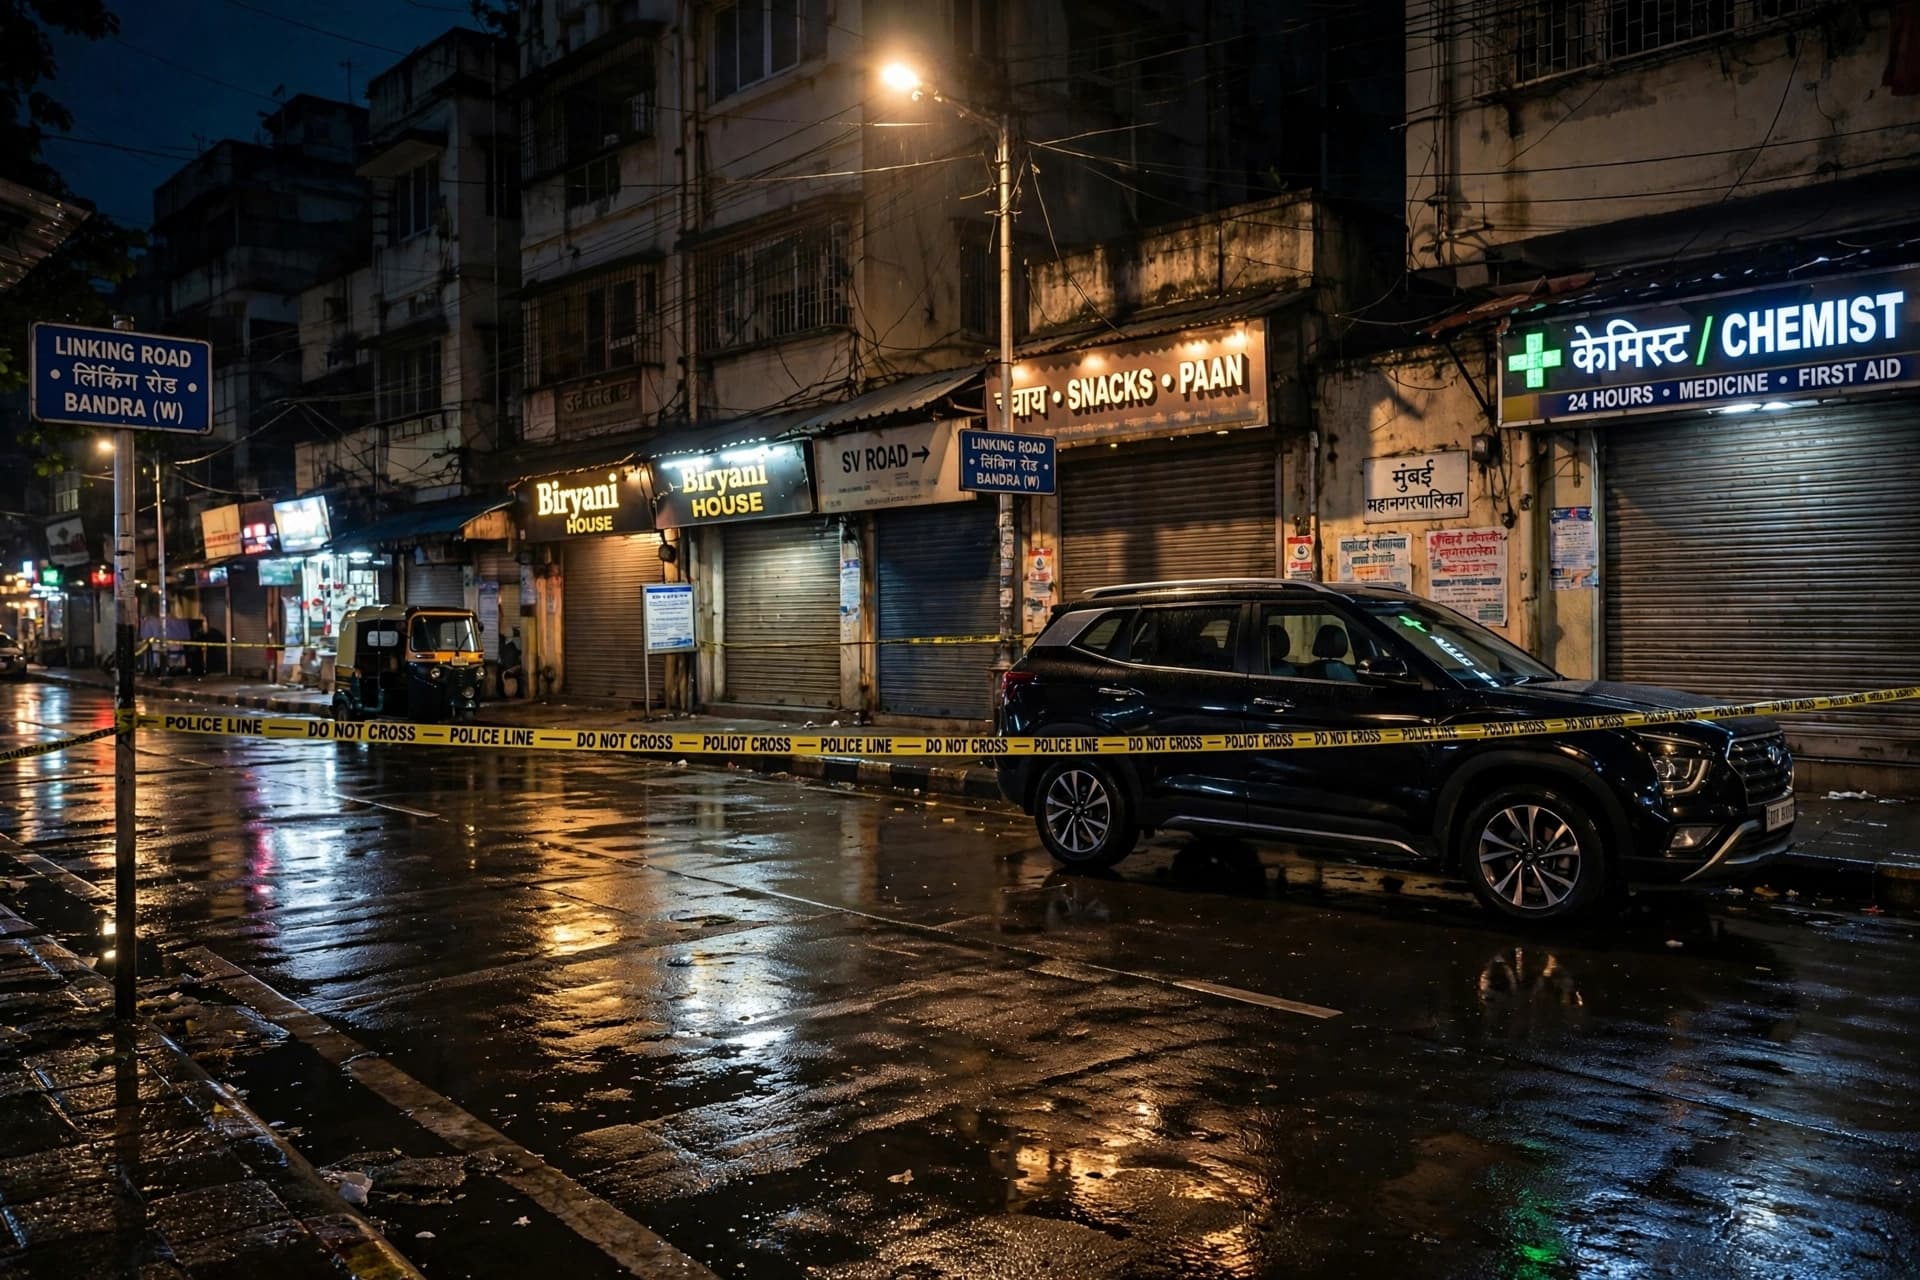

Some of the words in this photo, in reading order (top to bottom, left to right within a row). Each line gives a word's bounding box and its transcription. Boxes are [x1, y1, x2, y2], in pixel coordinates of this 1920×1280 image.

[1570, 318, 1691, 374] केमिस्ट
[1721, 291, 1904, 358] CHEMIST
[55, 335, 134, 362] LINKING
[141, 345, 192, 368] ROAD
[72, 361, 138, 391] लिंकिंग
[145, 369, 178, 394] रोड
[1067, 368, 1154, 411] SNACKS
[1178, 353, 1243, 395] PAAN
[1568, 393, 1588, 411] 24
[1593, 386, 1654, 410] HOURS
[1679, 373, 1769, 400] MEDICINE
[1799, 362, 1857, 388] FIRST
[1863, 358, 1901, 381] AID
[64, 392, 147, 418] BANDRA
[153, 400, 184, 424] (W)
[842, 450, 861, 473] SV
[865, 444, 909, 471] ROAD
[971, 437, 1015, 452] LINKING
[1018, 440, 1046, 454] ROAD
[682, 457, 768, 496] Biryani
[976, 472, 1020, 486] BANDRA
[1024, 475, 1040, 490] (W)
[1392, 459, 1435, 493] मुंबई
[536, 473, 619, 520] Biryani
[692, 491, 763, 518] HOUSE
[1367, 489, 1464, 514] महानगरपालिका
[566, 515, 614, 534] HOUSE
[165, 716, 222, 732] POLICE
[227, 719, 263, 734] LINE
[308, 721, 329, 737] DO
[334, 723, 364, 740] NOT
[368, 724, 416, 741] CROSS
[450, 727, 499, 744] POLICE
[503, 729, 534, 745] LINE
[576, 732, 596, 747] DO
[600, 733, 626, 748] NOT
[630, 734, 673, 750] CROSS
[703, 735, 747, 751] POLIOT
[751, 737, 791, 752] CROSS
[820, 738, 862, 752] POLICE
[866, 738, 892, 753] LINE
[926, 738, 943, 753] DO
[946, 738, 970, 753] NOT
[971, 739, 1008, 753] CROSS
[1034, 738, 1072, 752] POLICE
[1075, 737, 1099, 752] LINE
[1129, 737, 1143, 750] DO
[1147, 736, 1167, 750] NOT
[1169, 736, 1202, 750] CROSS
[1263, 734, 1294, 747] CROSS
[1314, 733, 1327, 745] DO
[1330, 731, 1349, 745] NOT
[1351, 729, 1381, 743] CROSS
[1517, 720, 1547, 734] CROSS
[1596, 715, 1624, 728] CROSS
